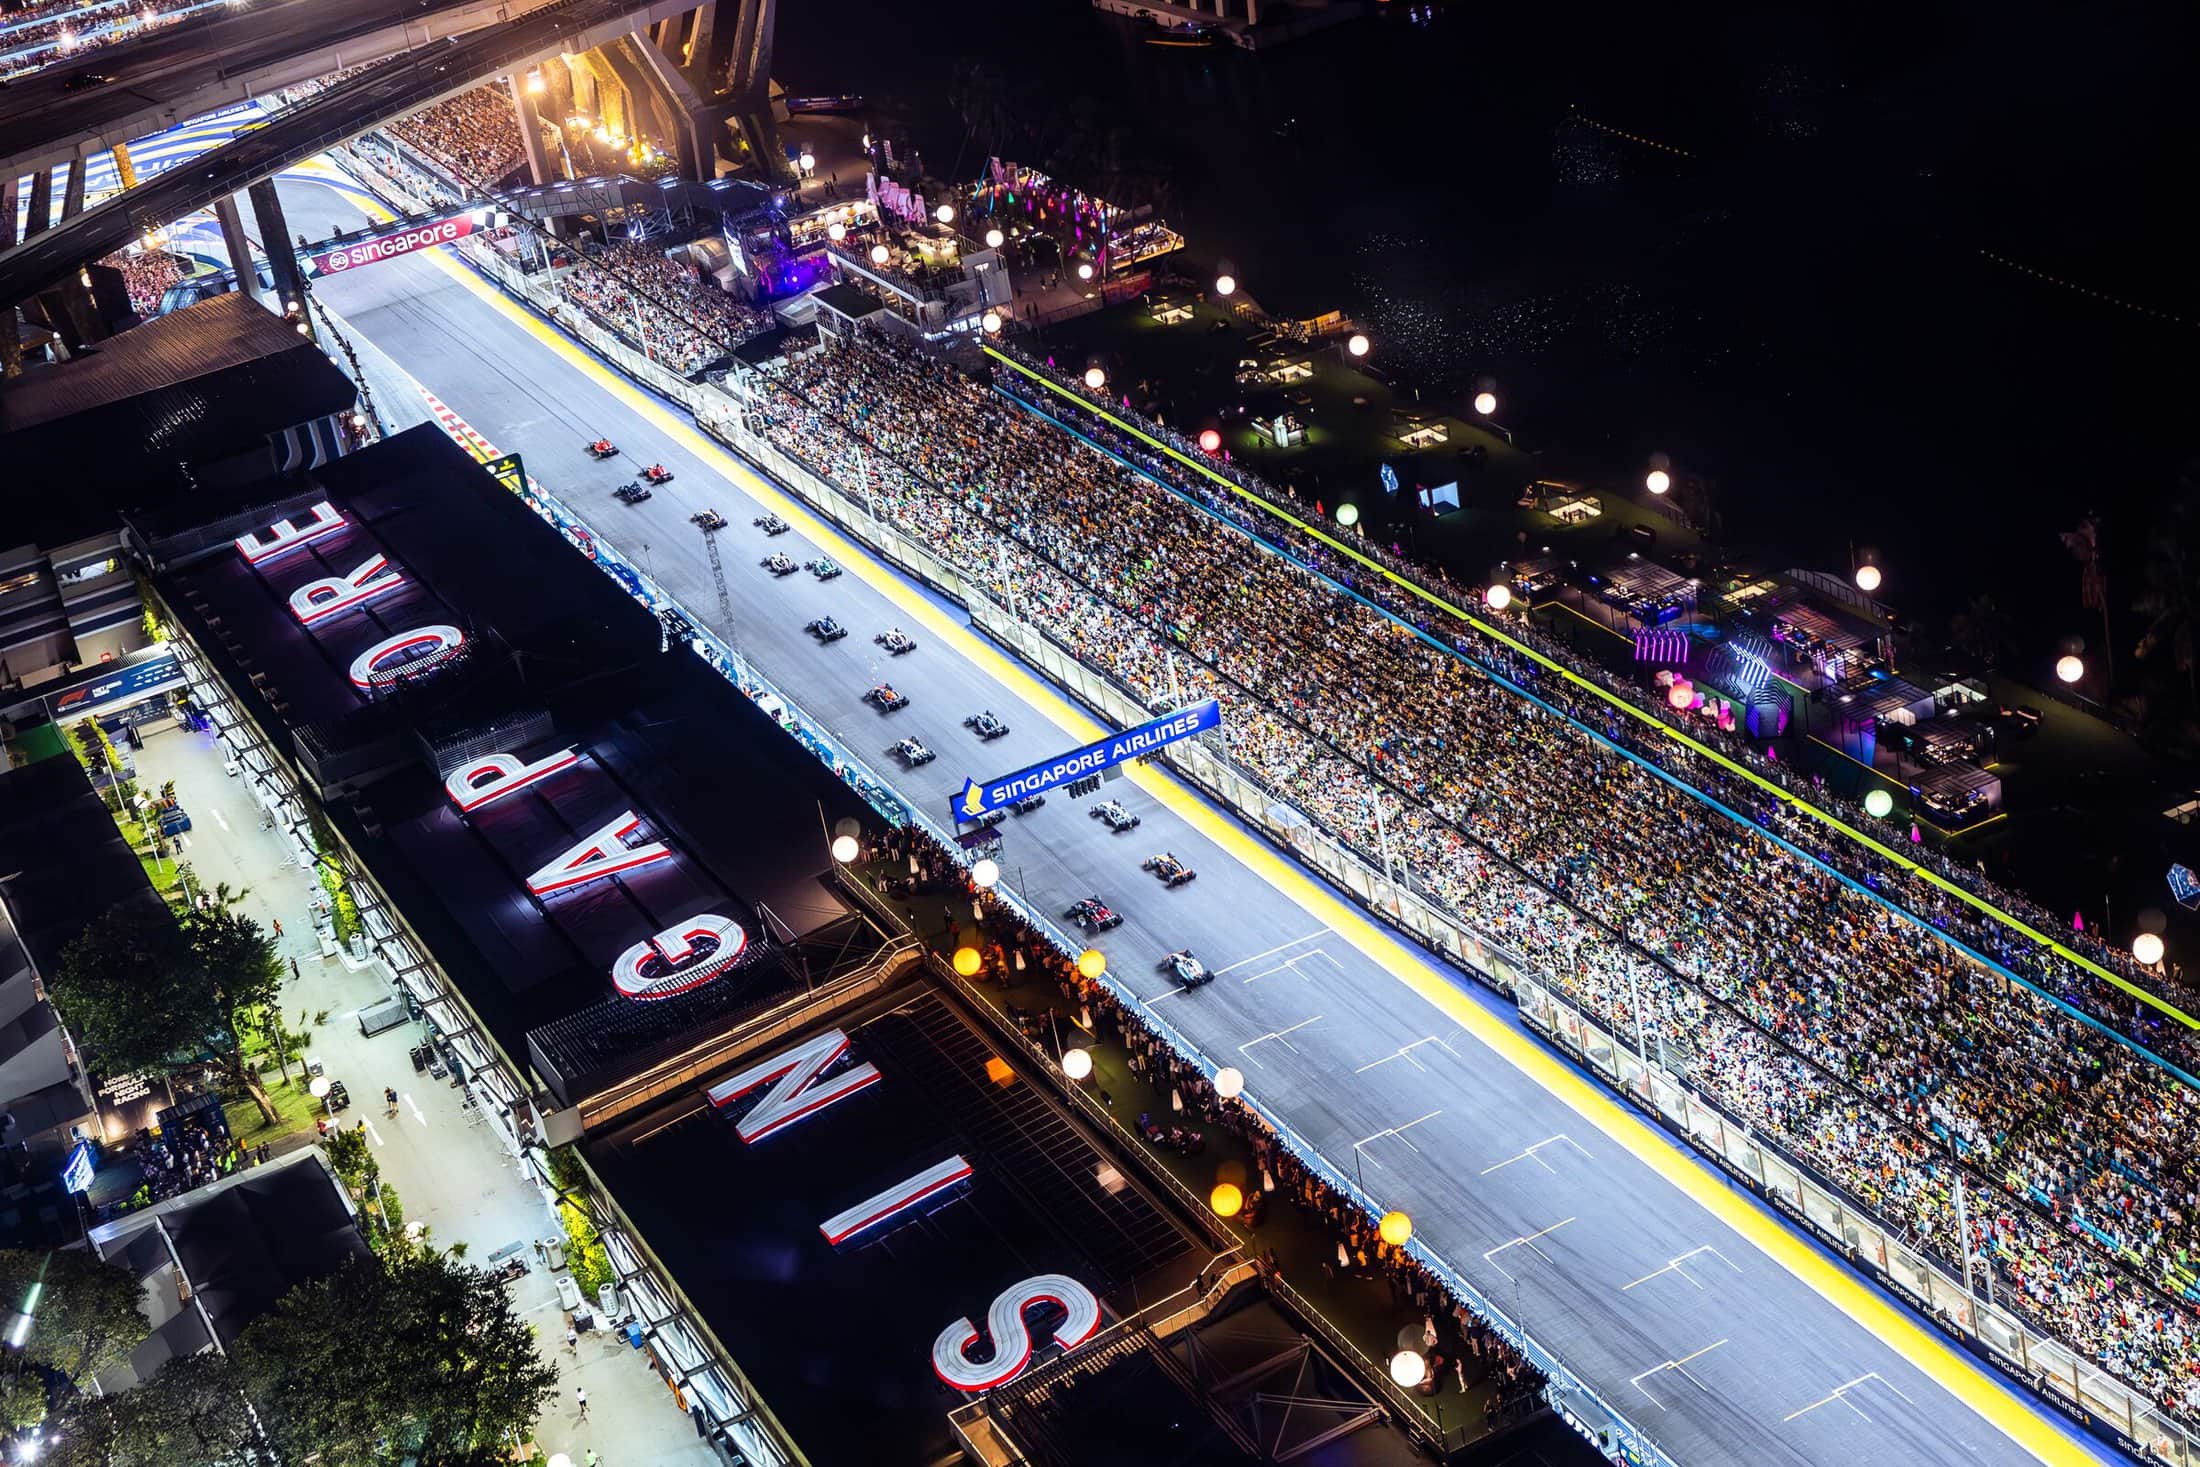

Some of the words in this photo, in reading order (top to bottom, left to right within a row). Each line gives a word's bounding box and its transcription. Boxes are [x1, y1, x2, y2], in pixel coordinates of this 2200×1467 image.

[992, 749, 1105, 804] SINGAPORE
[1111, 712, 1200, 760] AIRLINES
[1875, 1270, 1922, 1309] SINGAPORE
[2040, 1386, 2085, 1422] AIRLINES
